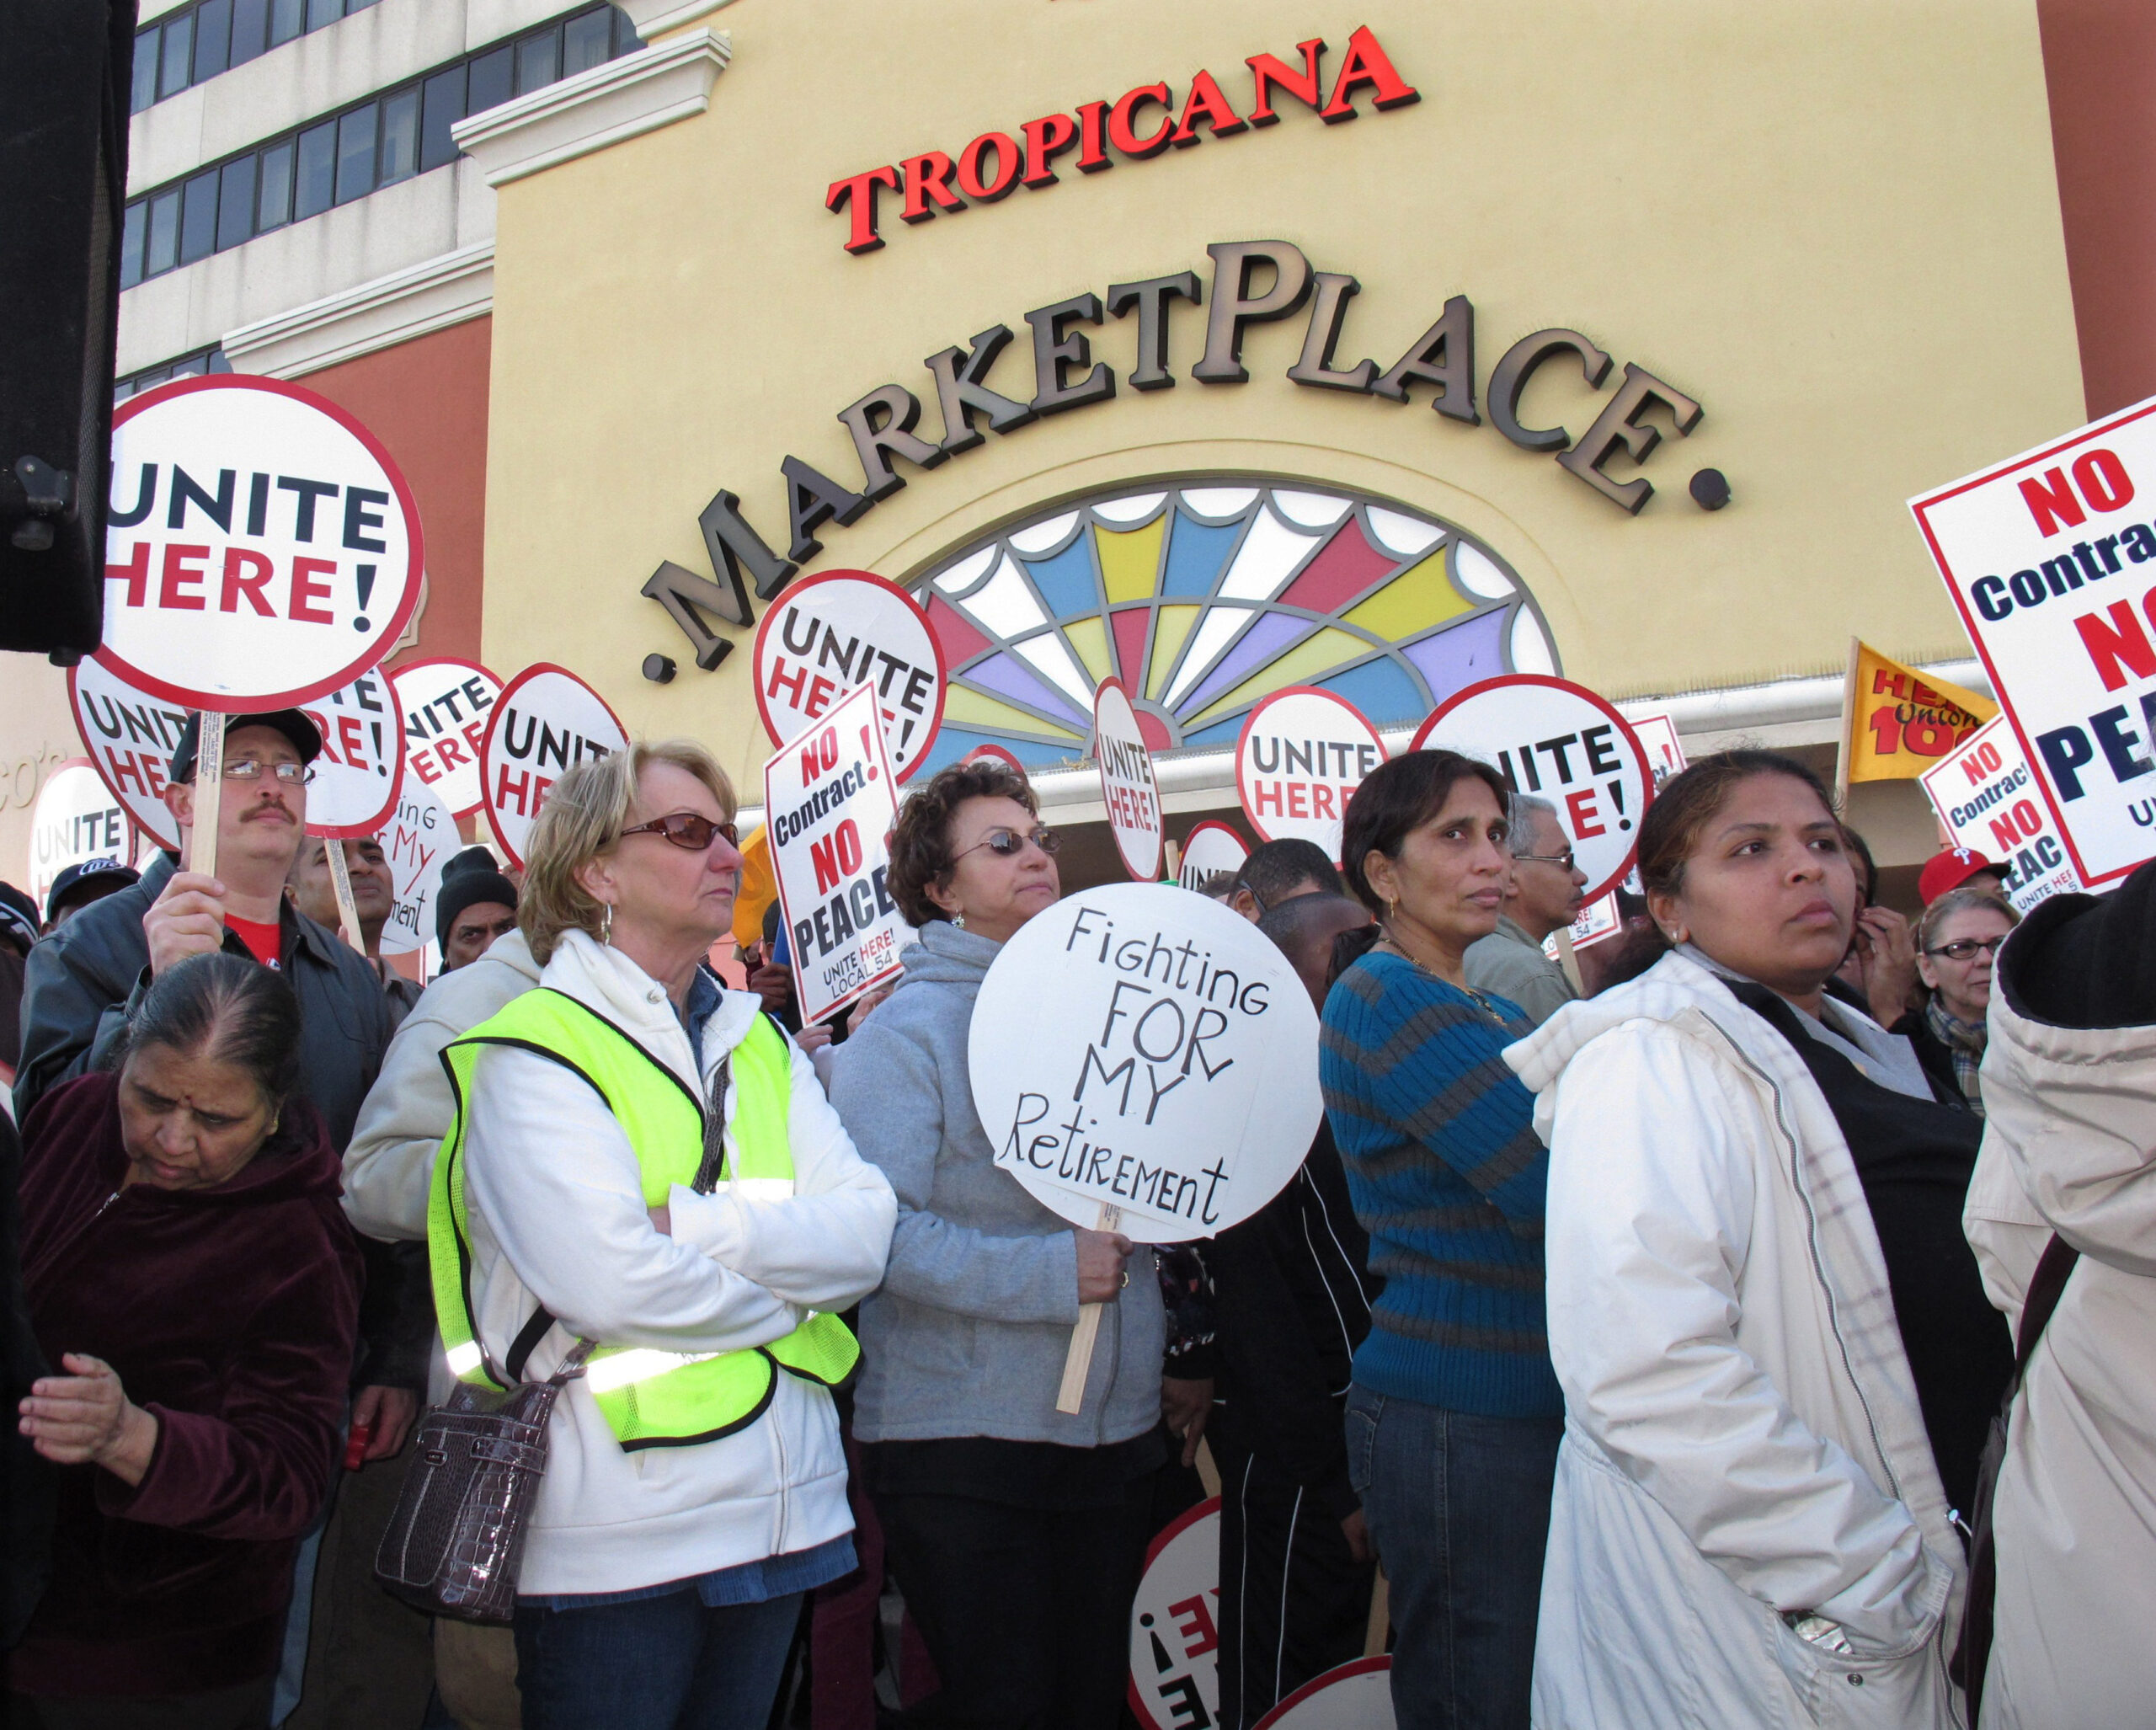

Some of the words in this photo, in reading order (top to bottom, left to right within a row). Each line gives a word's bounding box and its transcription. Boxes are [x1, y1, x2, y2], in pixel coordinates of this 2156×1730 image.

[825, 25, 1421, 255] TROPICANA
[108, 462, 389, 553] UNITE
[2017, 449, 2135, 538] NO
[105, 542, 376, 633] HERE!
[1971, 518, 2156, 621] Contra
[782, 606, 935, 715] UNITE
[81, 689, 188, 750] UNIT
[405, 675, 494, 751] NITE
[1869, 706, 1979, 756] 10
[800, 726, 839, 788] NO
[1099, 733, 1151, 784] UNITE
[1251, 735, 1376, 779] UNITE
[1959, 742, 2002, 787] NO
[1107, 784, 1159, 834] HERE!
[1950, 760, 2029, 828] Contrac
[38, 807, 120, 864] UNITE
[1988, 799, 2042, 853] NO
[810, 819, 862, 896] NO
[794, 864, 896, 969] PEACE
[2017, 884, 2052, 910] UNITE
[824, 951, 857, 985] UNITE
[859, 927, 895, 962] HERE!
[1576, 924, 1590, 937] 54
[831, 966, 873, 1000] LOCAL
[873, 950, 893, 974] 54
[1101, 980, 1233, 1081] FOR
[1073, 1044, 1186, 1125] MY
